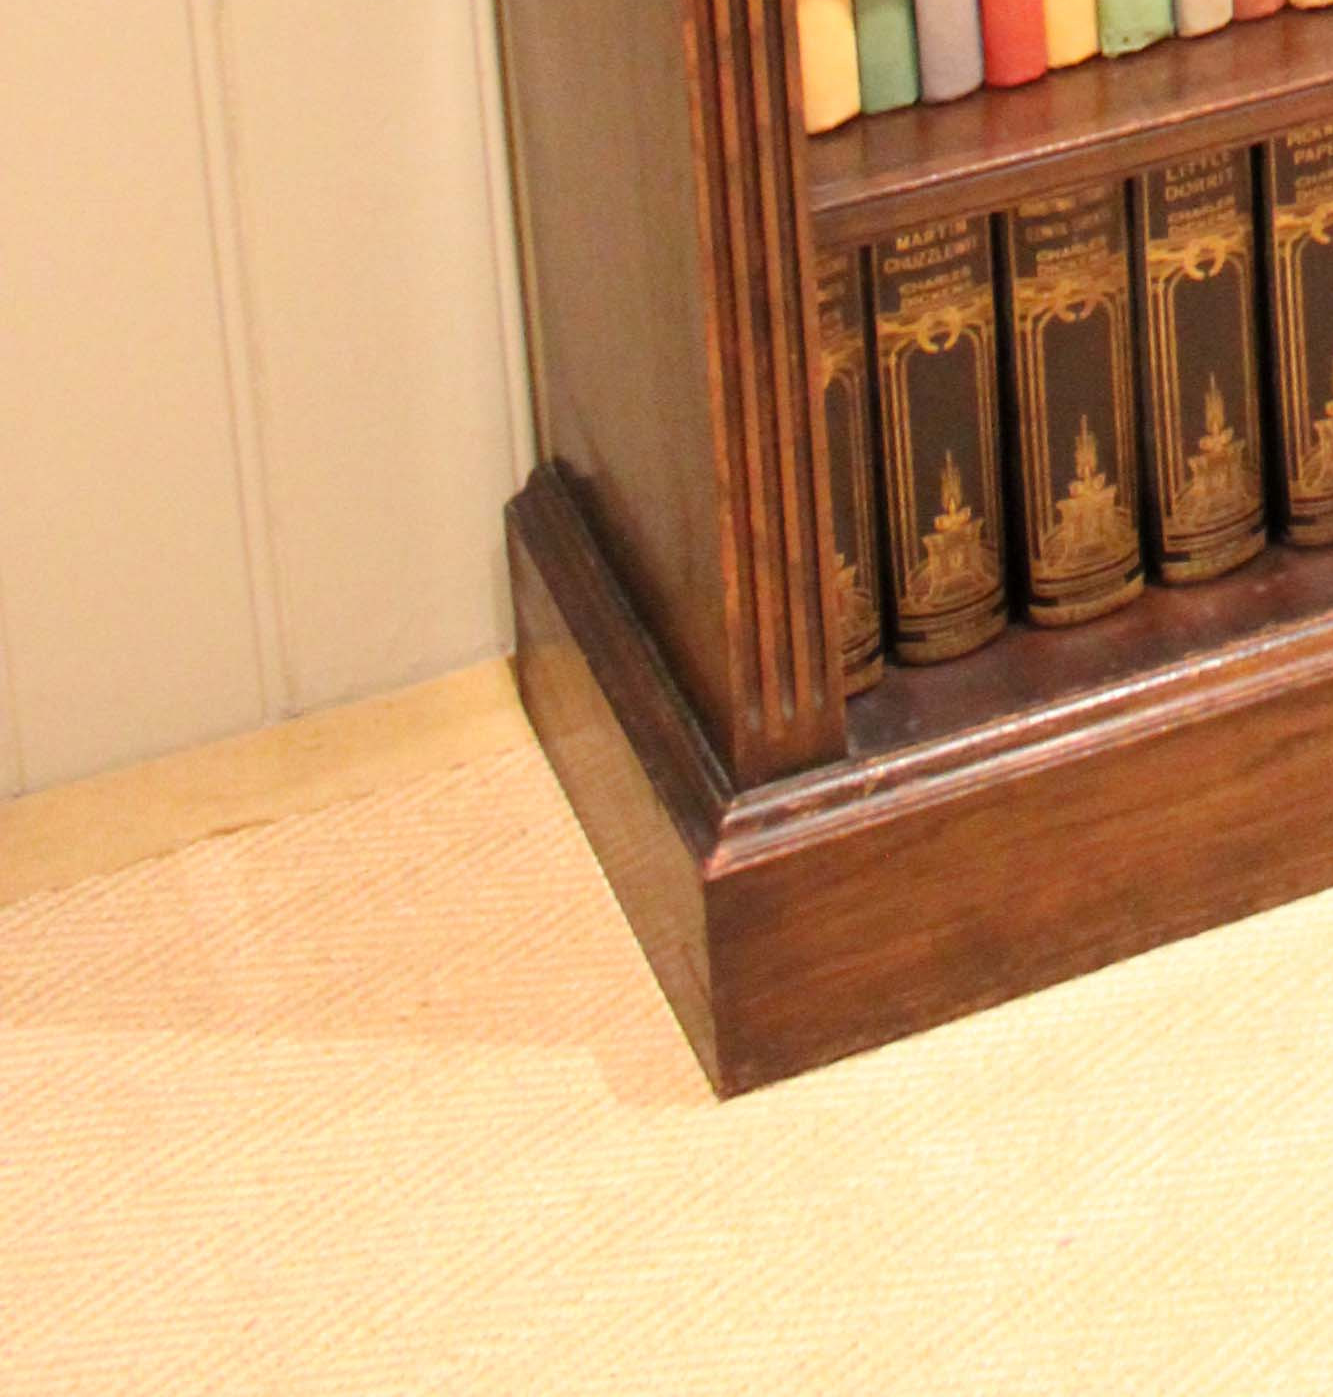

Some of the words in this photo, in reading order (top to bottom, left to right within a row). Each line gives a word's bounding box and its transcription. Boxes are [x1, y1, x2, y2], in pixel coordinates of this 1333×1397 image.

[1164, 150, 1232, 183] LITTLE
[1164, 166, 1234, 203] DORRIT
[1167, 195, 1236, 224] CHARLES
[896, 219, 969, 252] MARTIN
[899, 265, 972, 297] CHARLES
